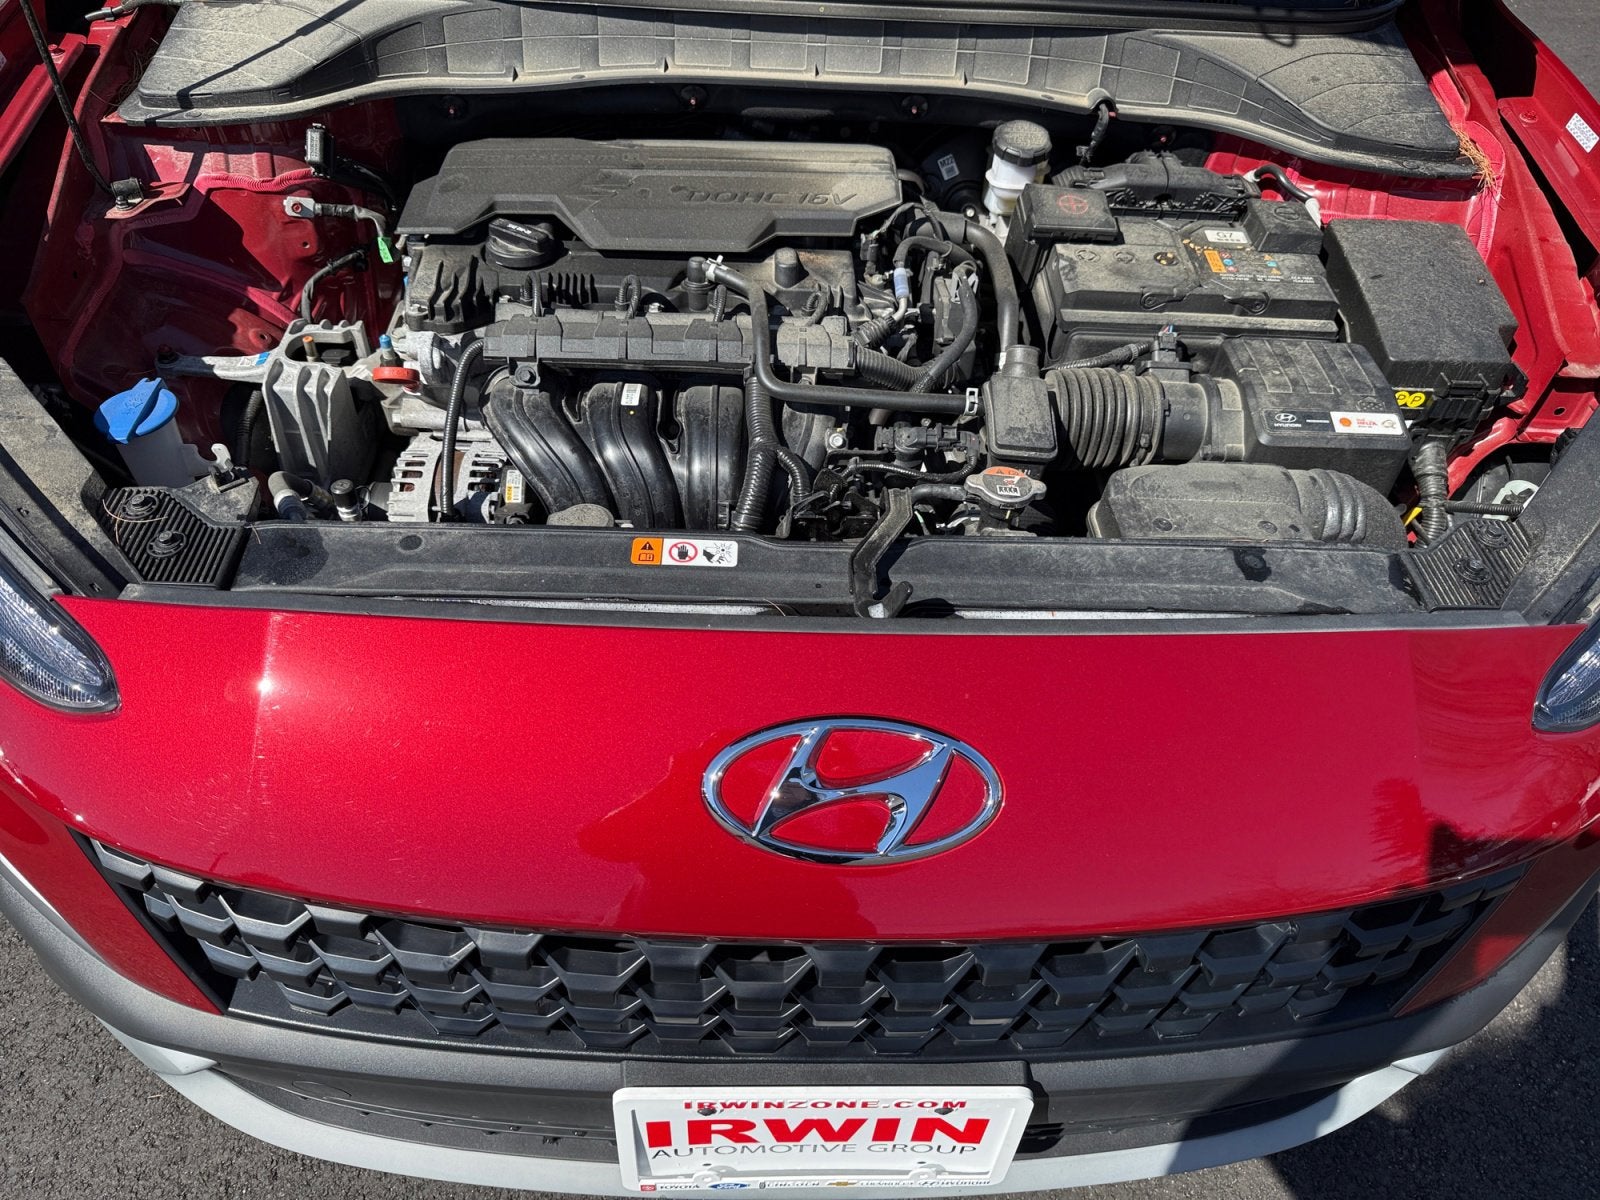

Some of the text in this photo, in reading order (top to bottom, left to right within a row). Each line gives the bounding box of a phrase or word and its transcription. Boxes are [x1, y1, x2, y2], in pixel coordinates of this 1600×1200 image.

[684, 190, 858, 206] DOHC 16V
[684, 1100, 967, 1110] IRWINZONE.COM
[646, 1117, 990, 1148] IRWIN
[652, 1143, 978, 1159] AUTOMOTIVE GROUP
